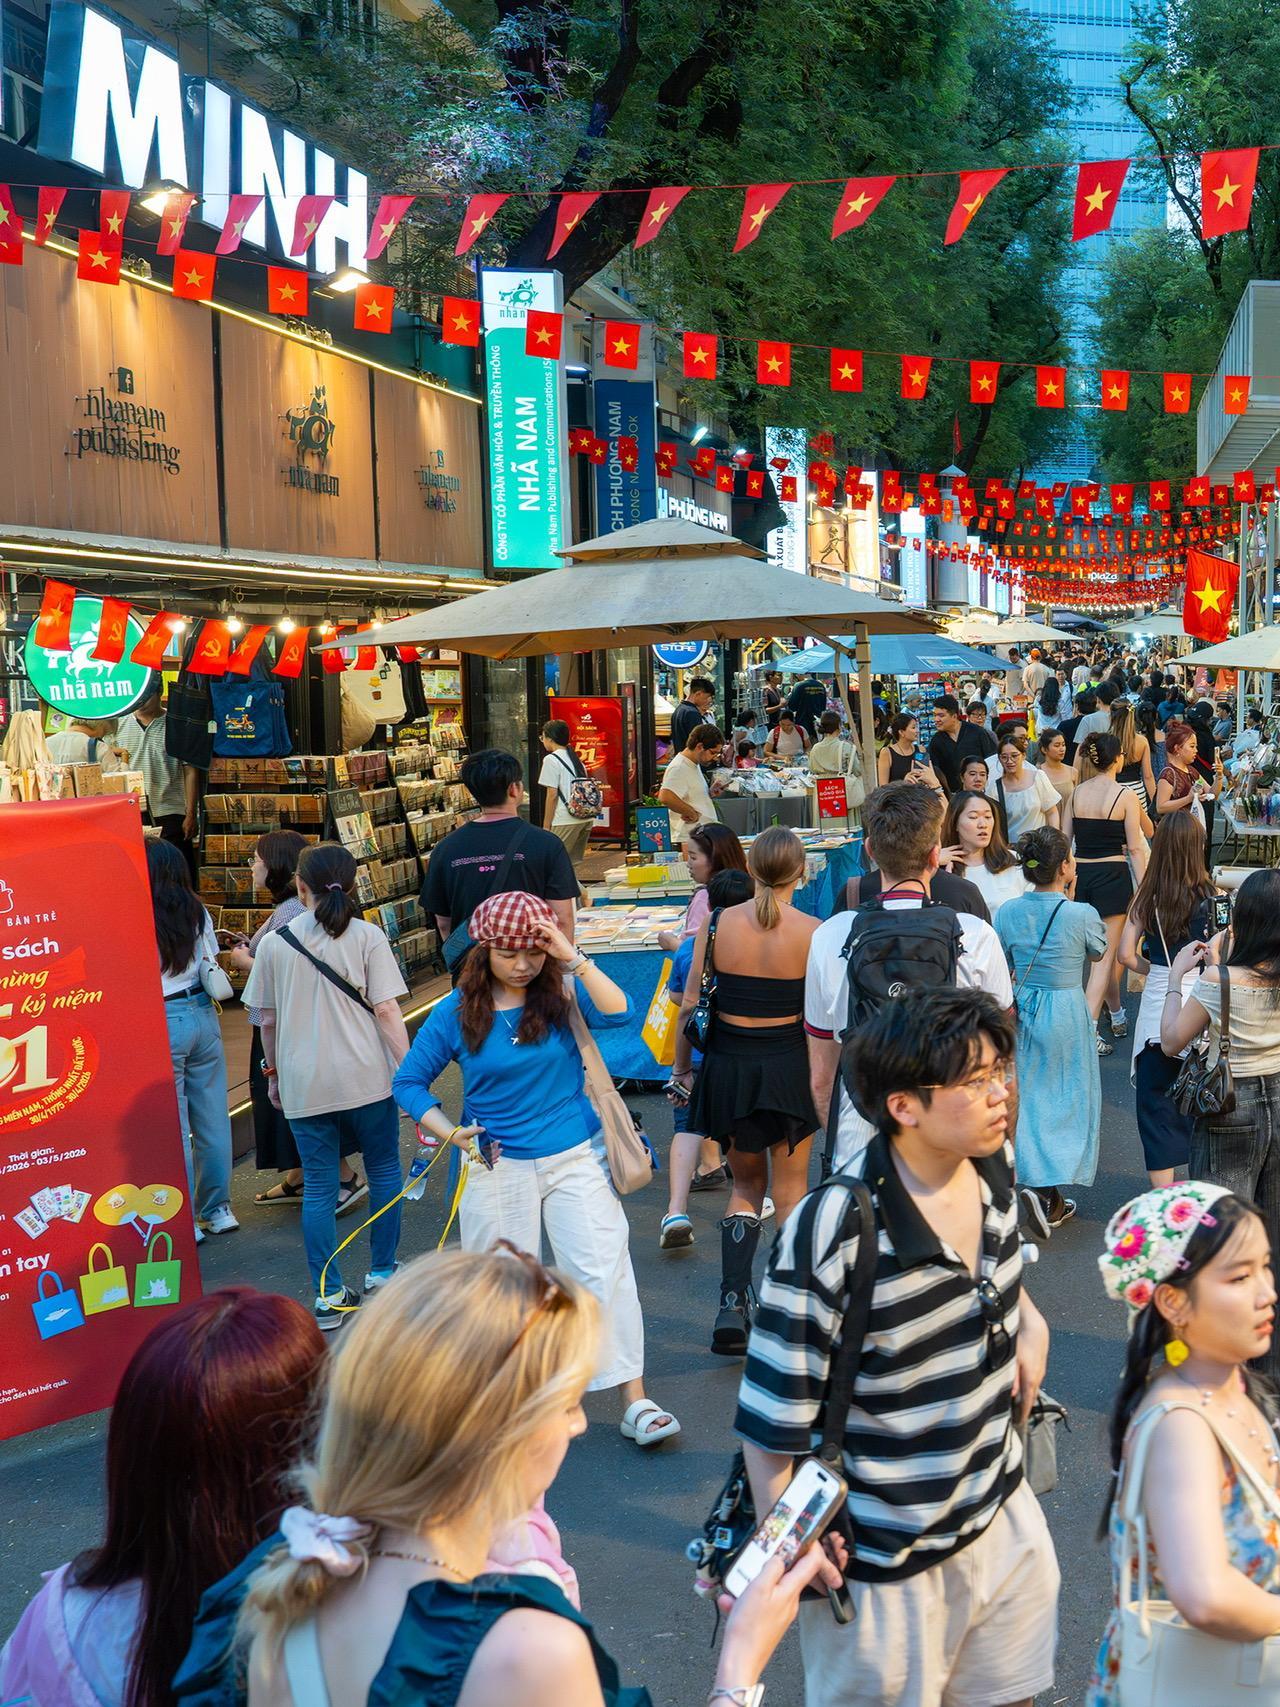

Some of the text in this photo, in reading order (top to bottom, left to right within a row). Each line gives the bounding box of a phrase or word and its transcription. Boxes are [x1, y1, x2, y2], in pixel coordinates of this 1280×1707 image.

[72, 7, 368, 274] MINH
[490, 345, 501, 380] THÔNG
[544, 372, 555, 446] Communications
[78, 419, 180, 475] publishing
[492, 431, 503, 451] HÓA
[493, 454, 504, 474] VĂN
[510, 397, 541, 511] NHÃ NAM
[545, 448, 555, 465] and
[608, 401, 624, 532] CH PHƯƠNG NAM
[546, 468, 557, 512] Publishing
[493, 504, 506, 518] CỔ
[630, 489, 640, 524] UONG
[668, 497, 709, 527] PHƯƠNG
[709, 511, 728, 531] NAM
[497, 520, 507, 531] TY
[548, 515, 558, 535] Nam
[496, 533, 508, 560] CÔNG
[660, 644, 697, 652] STORE
[49, 678, 134, 702] nhã nam
[574, 742, 597, 763] 51
[641, 819, 668, 829] -50%
[7, 910, 57, 927] BẢN TRẺ
[3, 937, 59, 960] sách
[21, 990, 103, 1018] kỷ niệm
[29, 1101, 65, 1125] 30/4/1975
[8, 1147, 55, 1163] Thời gian:
[36, 1148, 87, 1166] 03/5/2026
[16, 1253, 50, 1272] tay
[28, 1386, 39, 1396] khi
